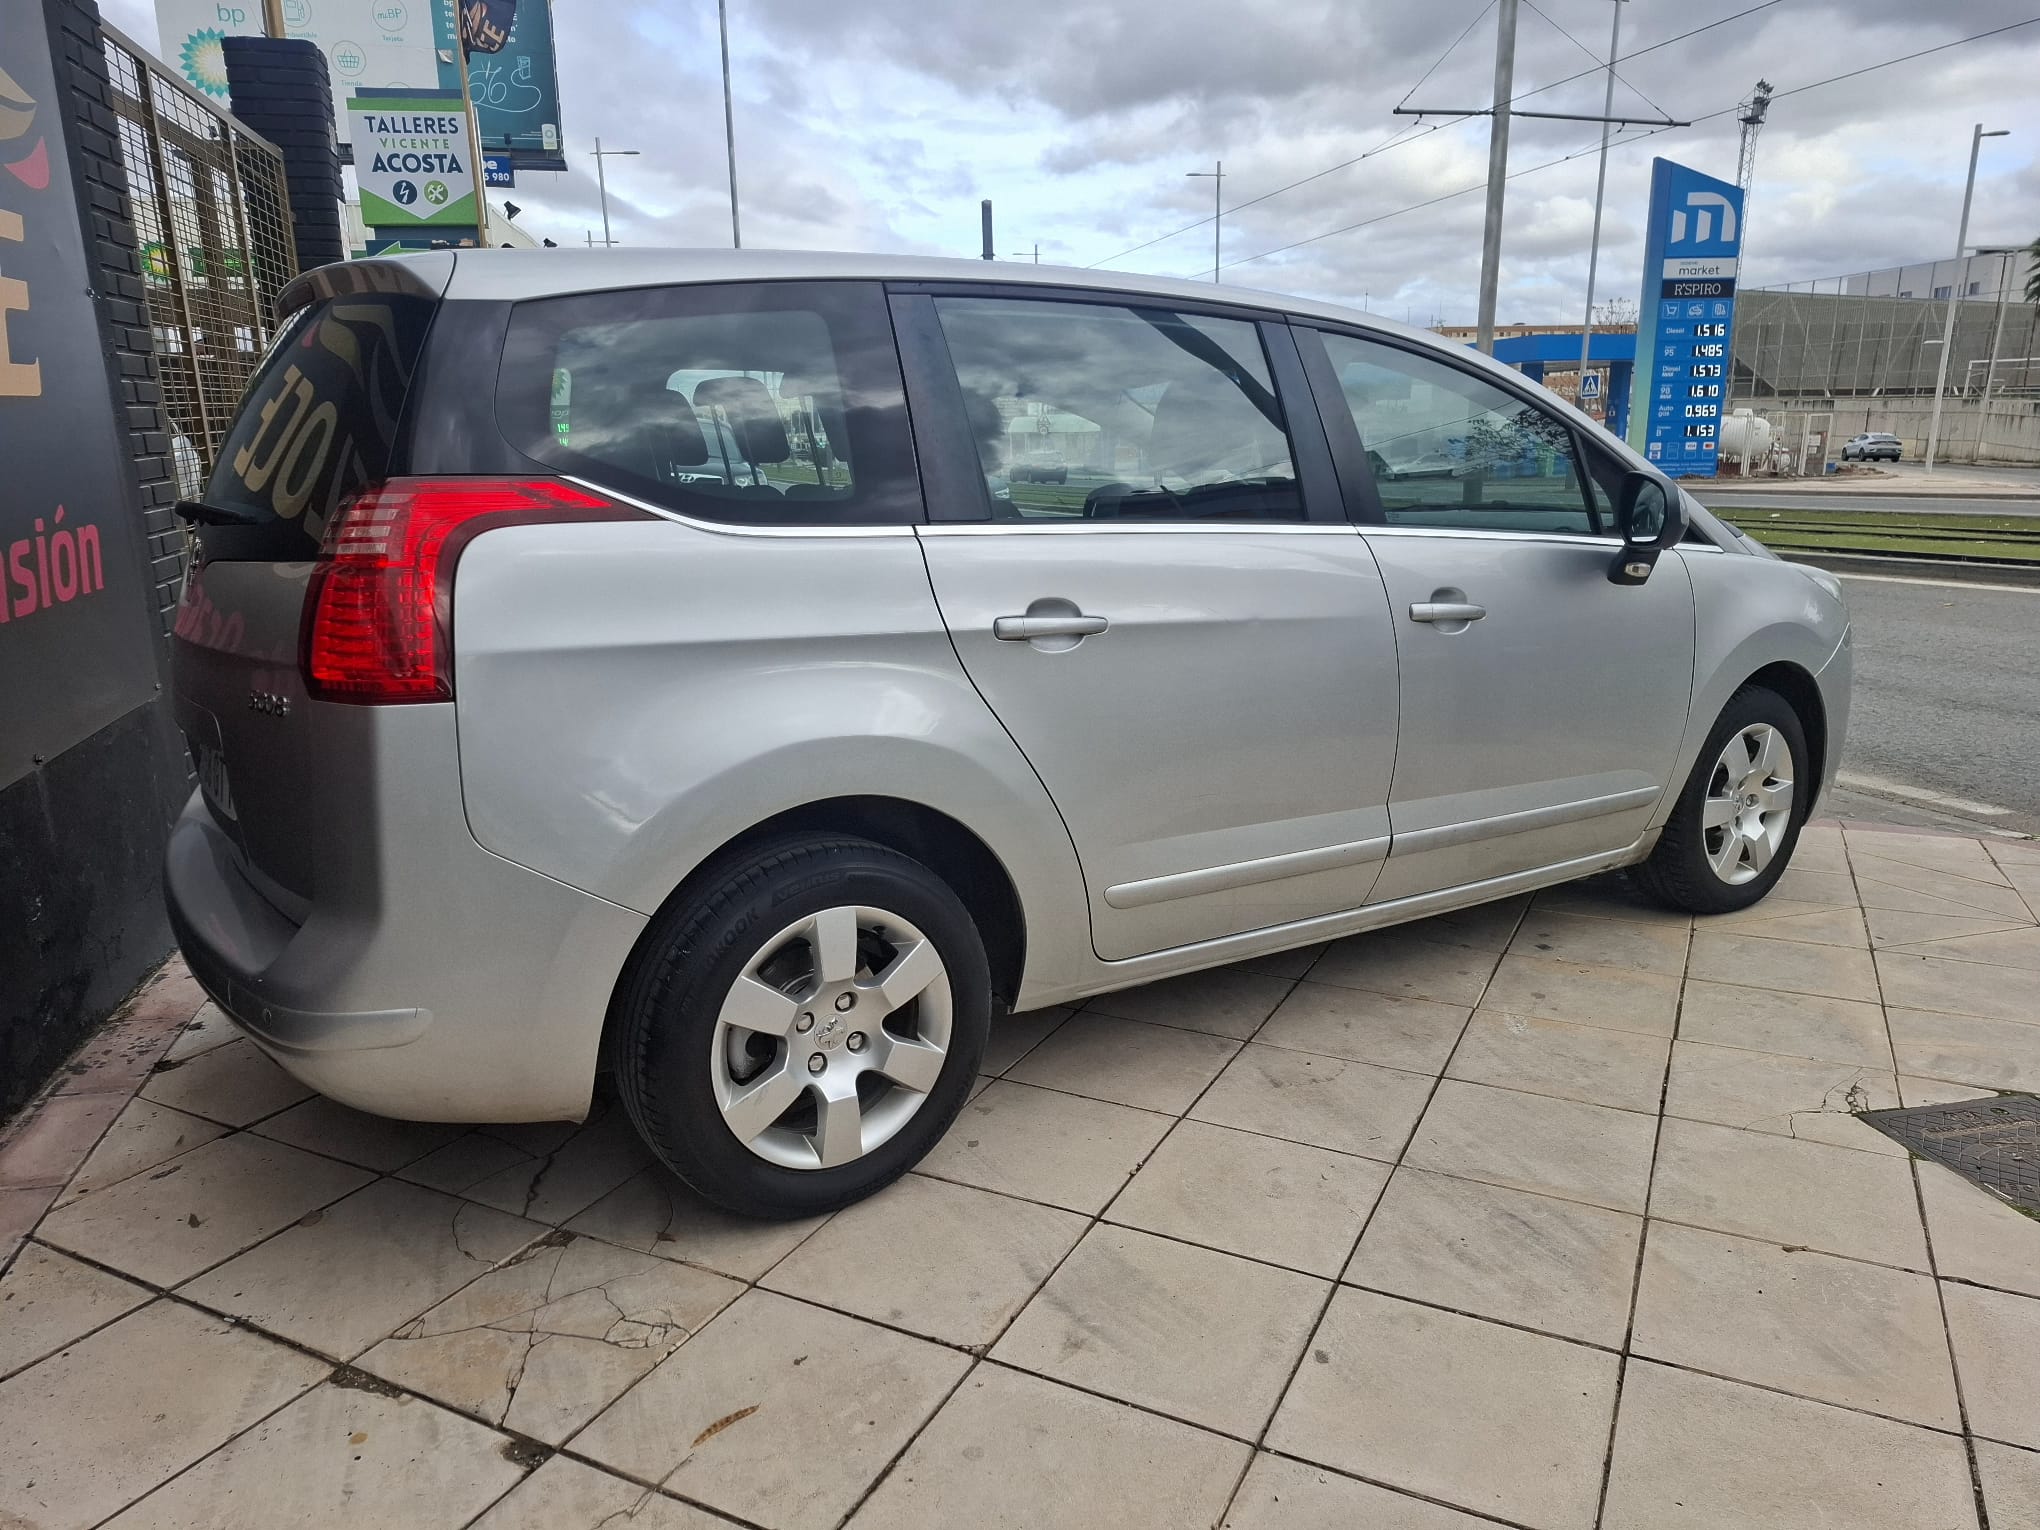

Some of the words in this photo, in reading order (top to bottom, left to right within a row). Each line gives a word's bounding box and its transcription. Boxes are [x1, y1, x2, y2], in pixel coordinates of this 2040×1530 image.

[217, 3, 245, 27] bp
[364, 116, 458, 135] TALLERES
[379, 138, 449, 149] VICENTE
[372, 152, 463, 174] ACOSTA
[492, 172, 510, 181] 980
[1678, 265, 1720, 276] market
[1674, 282, 1722, 296] R'SPIRO
[1697, 323, 1725, 337] 1.516
[1664, 349, 1674, 357] 95
[1695, 344, 1723, 357] 1.485
[1693, 364, 1721, 377] 1.573
[1691, 384, 1719, 397] 1.610
[1685, 404, 1717, 418] 0.969
[1686, 424, 1715, 437] 1.153
